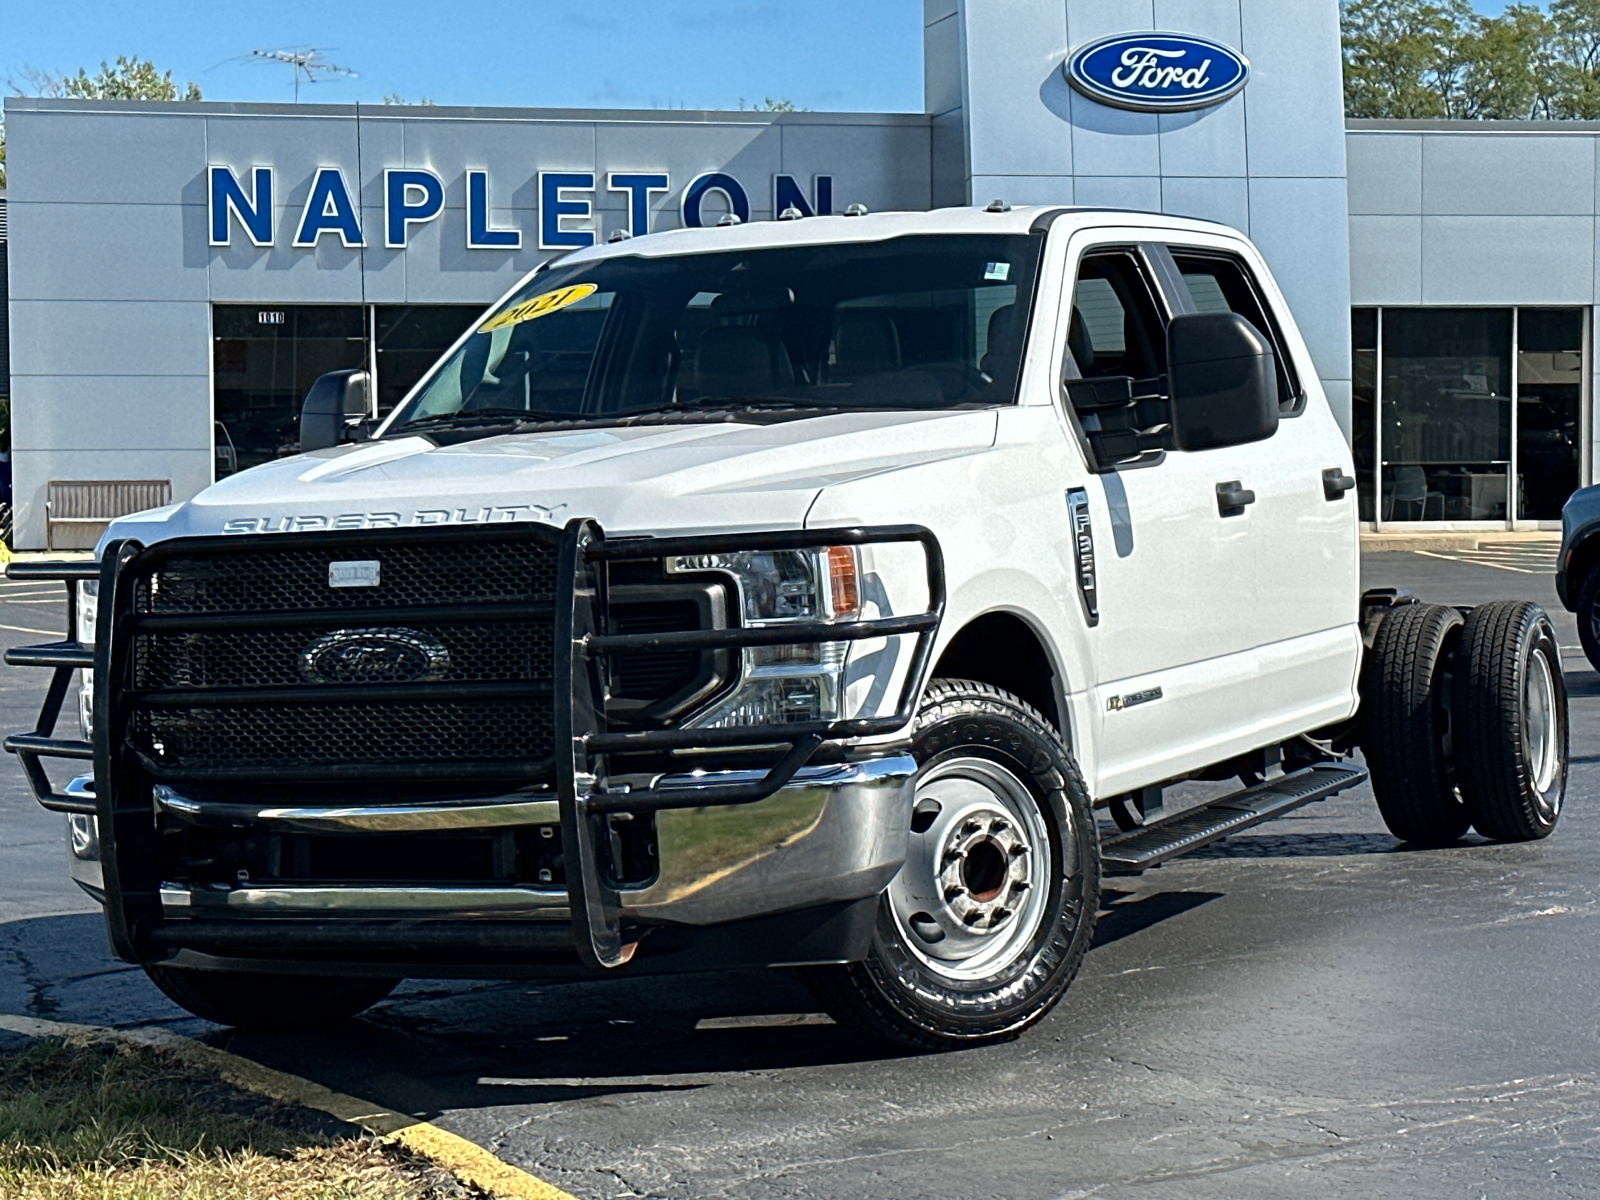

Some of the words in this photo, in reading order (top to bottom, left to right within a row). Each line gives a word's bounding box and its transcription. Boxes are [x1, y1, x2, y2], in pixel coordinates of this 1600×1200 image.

[1111, 47, 1212, 88] Ford
[207, 165, 833, 250] NAPLETON
[259, 311, 284, 323] 1010
[493, 289, 576, 327] 2021
[222, 511, 402, 536] SUPER
[410, 503, 568, 526] DUTY
